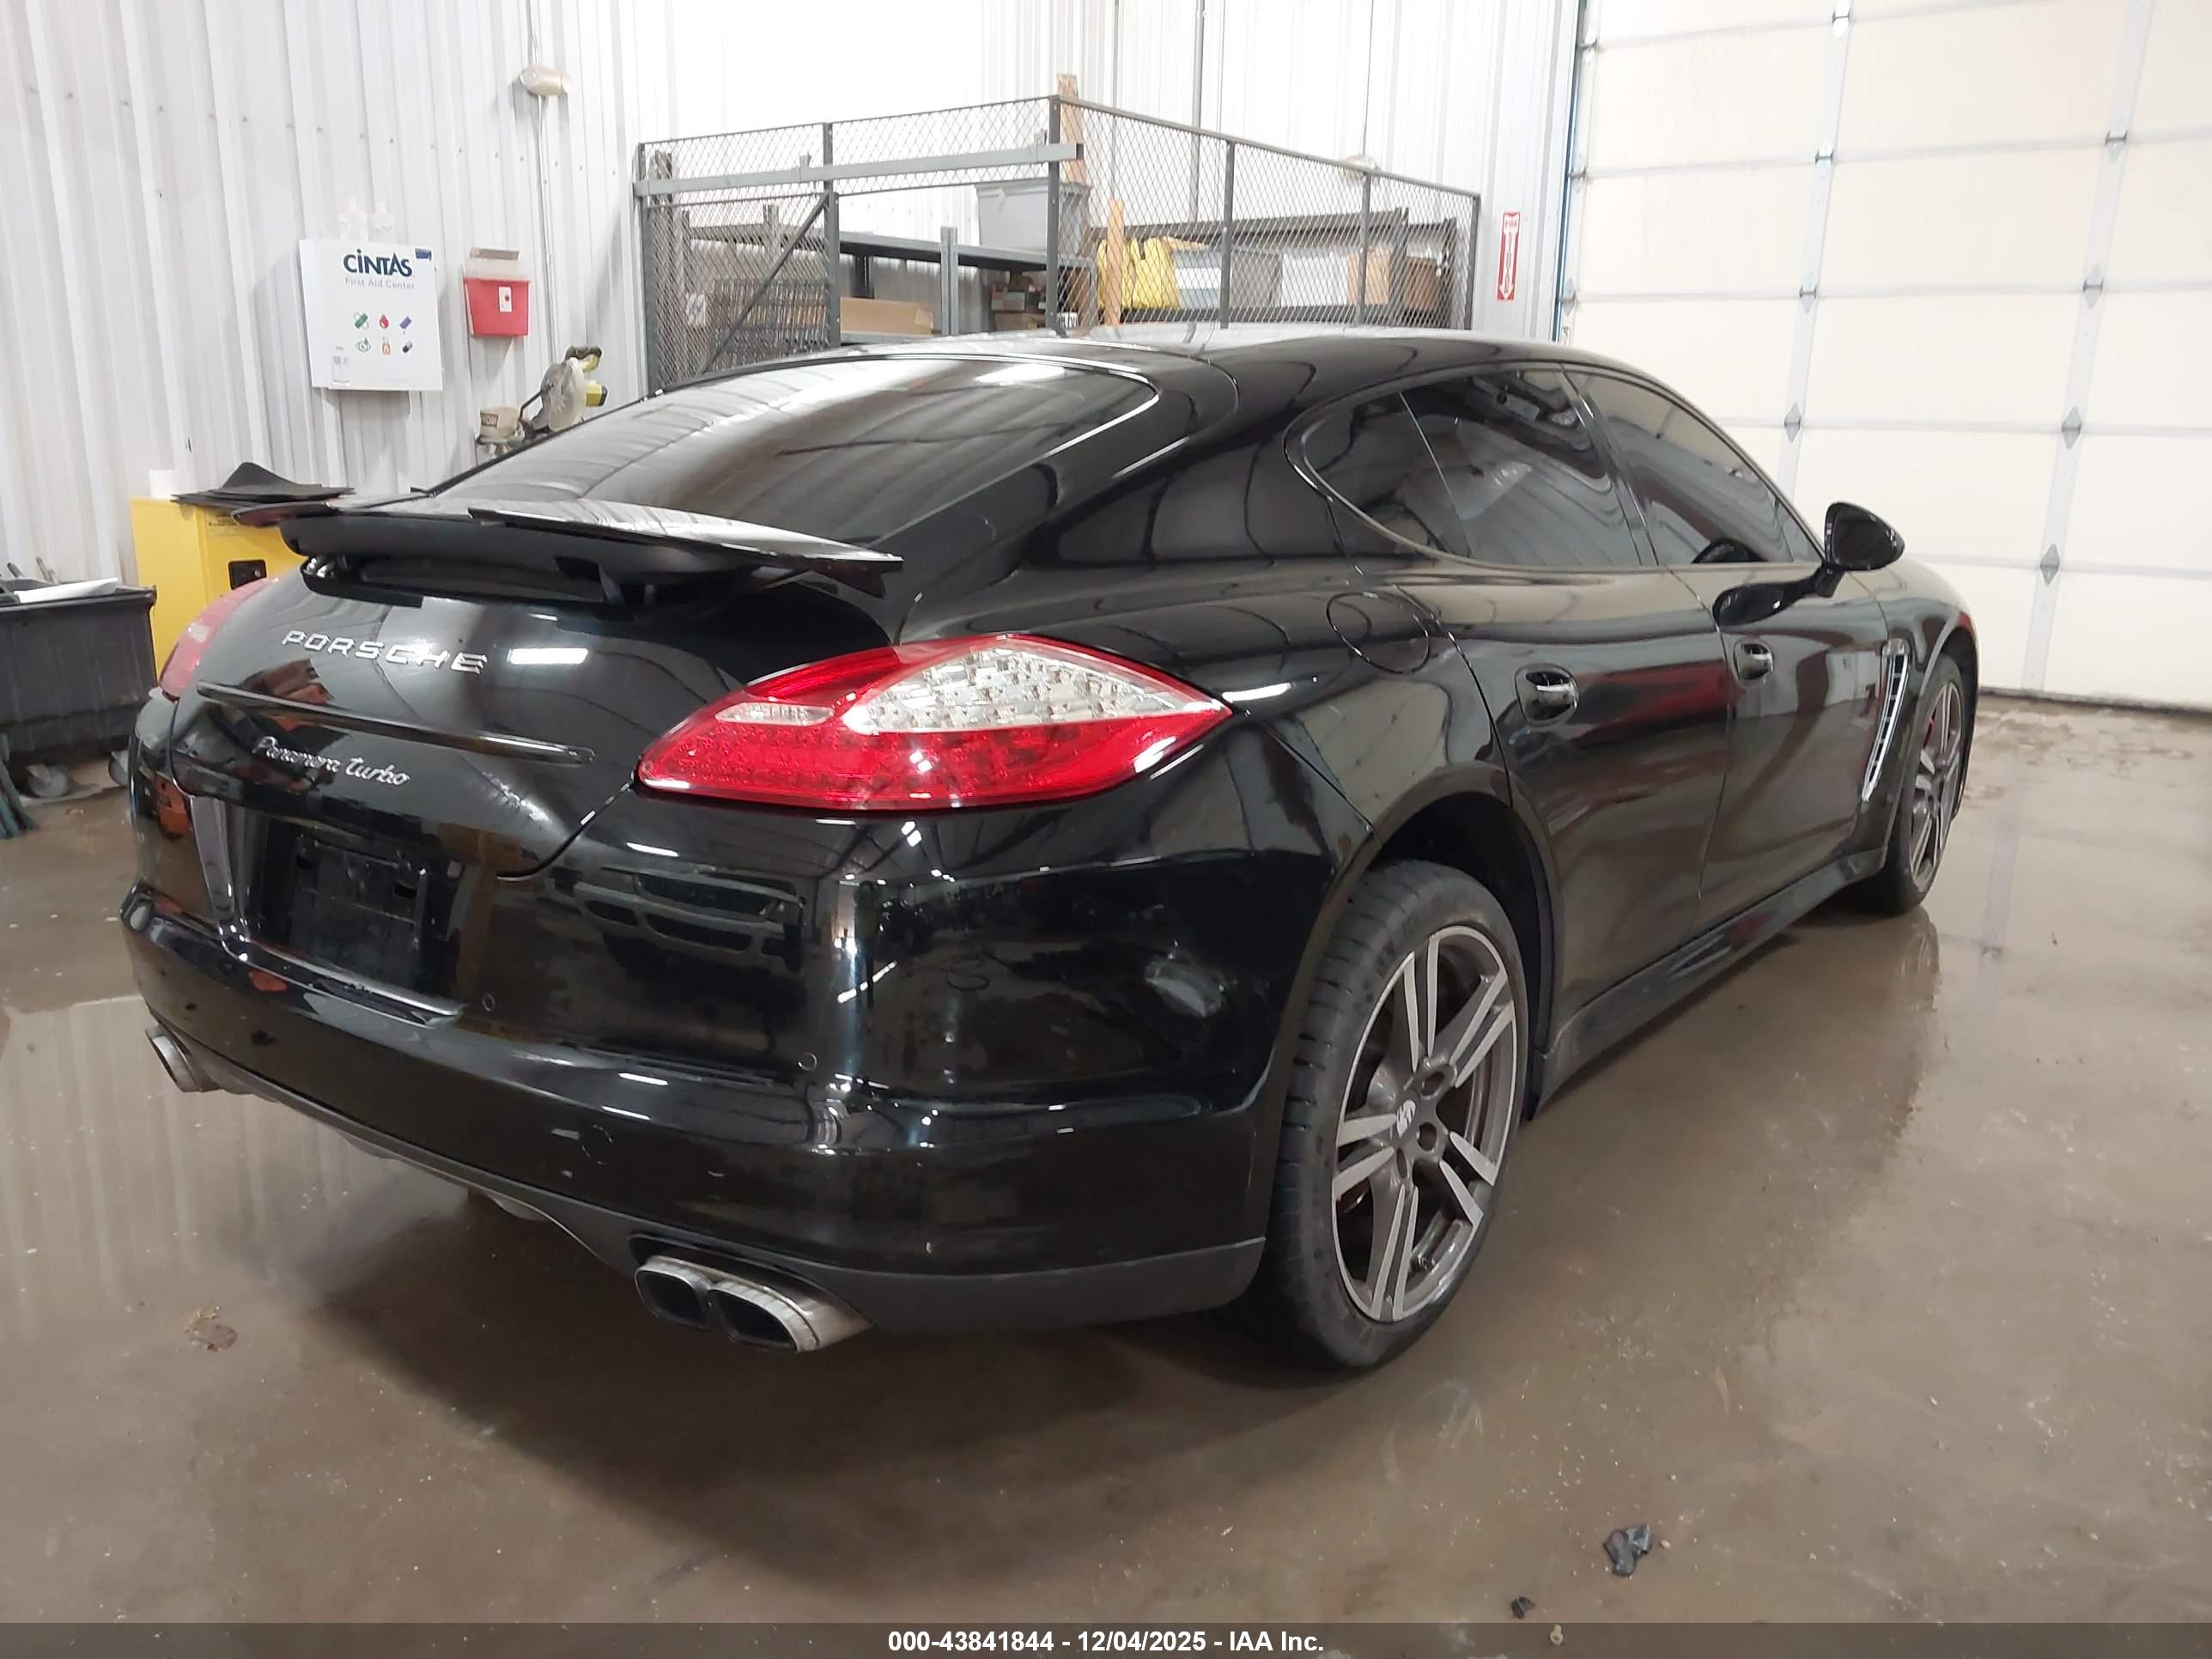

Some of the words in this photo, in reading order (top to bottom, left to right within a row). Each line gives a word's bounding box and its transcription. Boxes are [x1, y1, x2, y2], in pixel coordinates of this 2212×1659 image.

[344, 276, 364, 287] First
[368, 278, 383, 288] Aid
[385, 280, 414, 289] Center
[282, 630, 488, 675] PORSCHE
